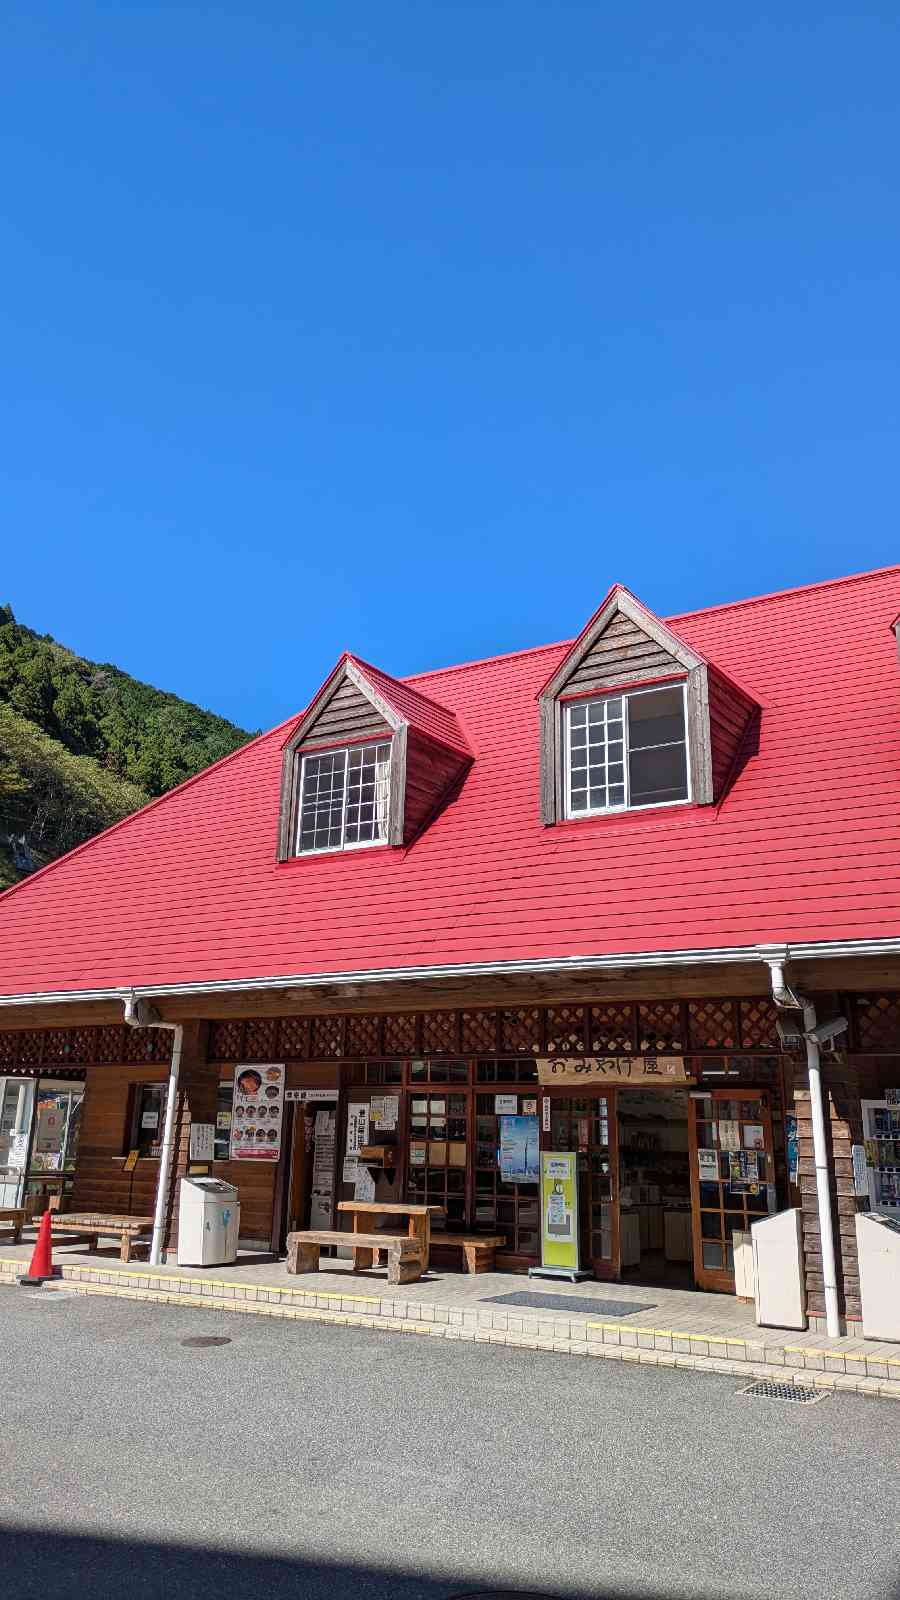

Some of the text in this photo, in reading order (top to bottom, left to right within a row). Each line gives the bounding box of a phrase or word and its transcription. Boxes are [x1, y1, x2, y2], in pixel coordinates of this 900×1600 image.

[548, 1058, 663, 1077] おみやげ屋
